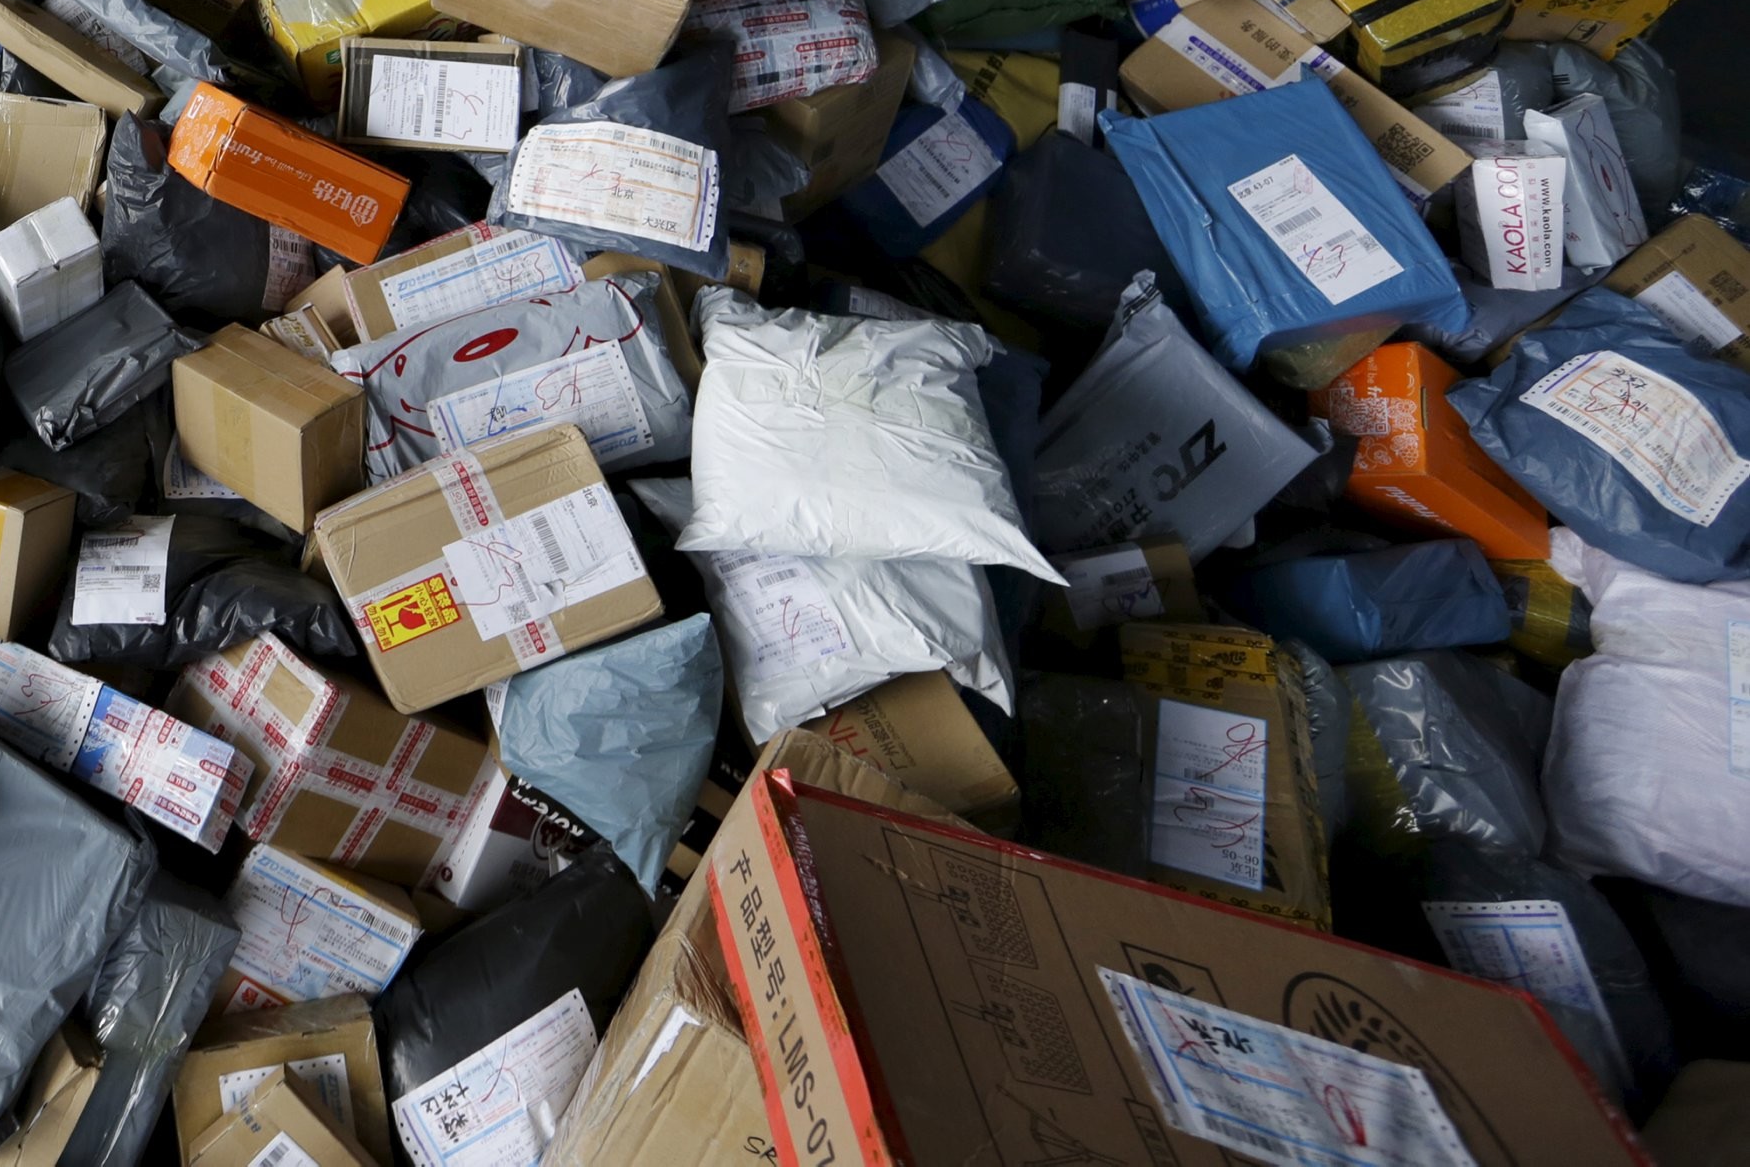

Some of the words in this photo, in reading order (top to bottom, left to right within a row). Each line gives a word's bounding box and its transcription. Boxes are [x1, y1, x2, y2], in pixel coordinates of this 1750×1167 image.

[612, 184, 635, 201] 北京
[1252, 177, 1275, 194] 43-07
[642, 214, 678, 234] 大兴区
[1541, 178, 1553, 269] www.kaola.com
[583, 487, 598, 509] 北京
[413, 585, 440, 629] 小心轻放
[428, 577, 459, 626] 易碎品
[858, 698, 908, 772] 广州瓷肌化
[257, 854, 279, 872] ZTO
[1229, 862, 1259, 879] 北京
